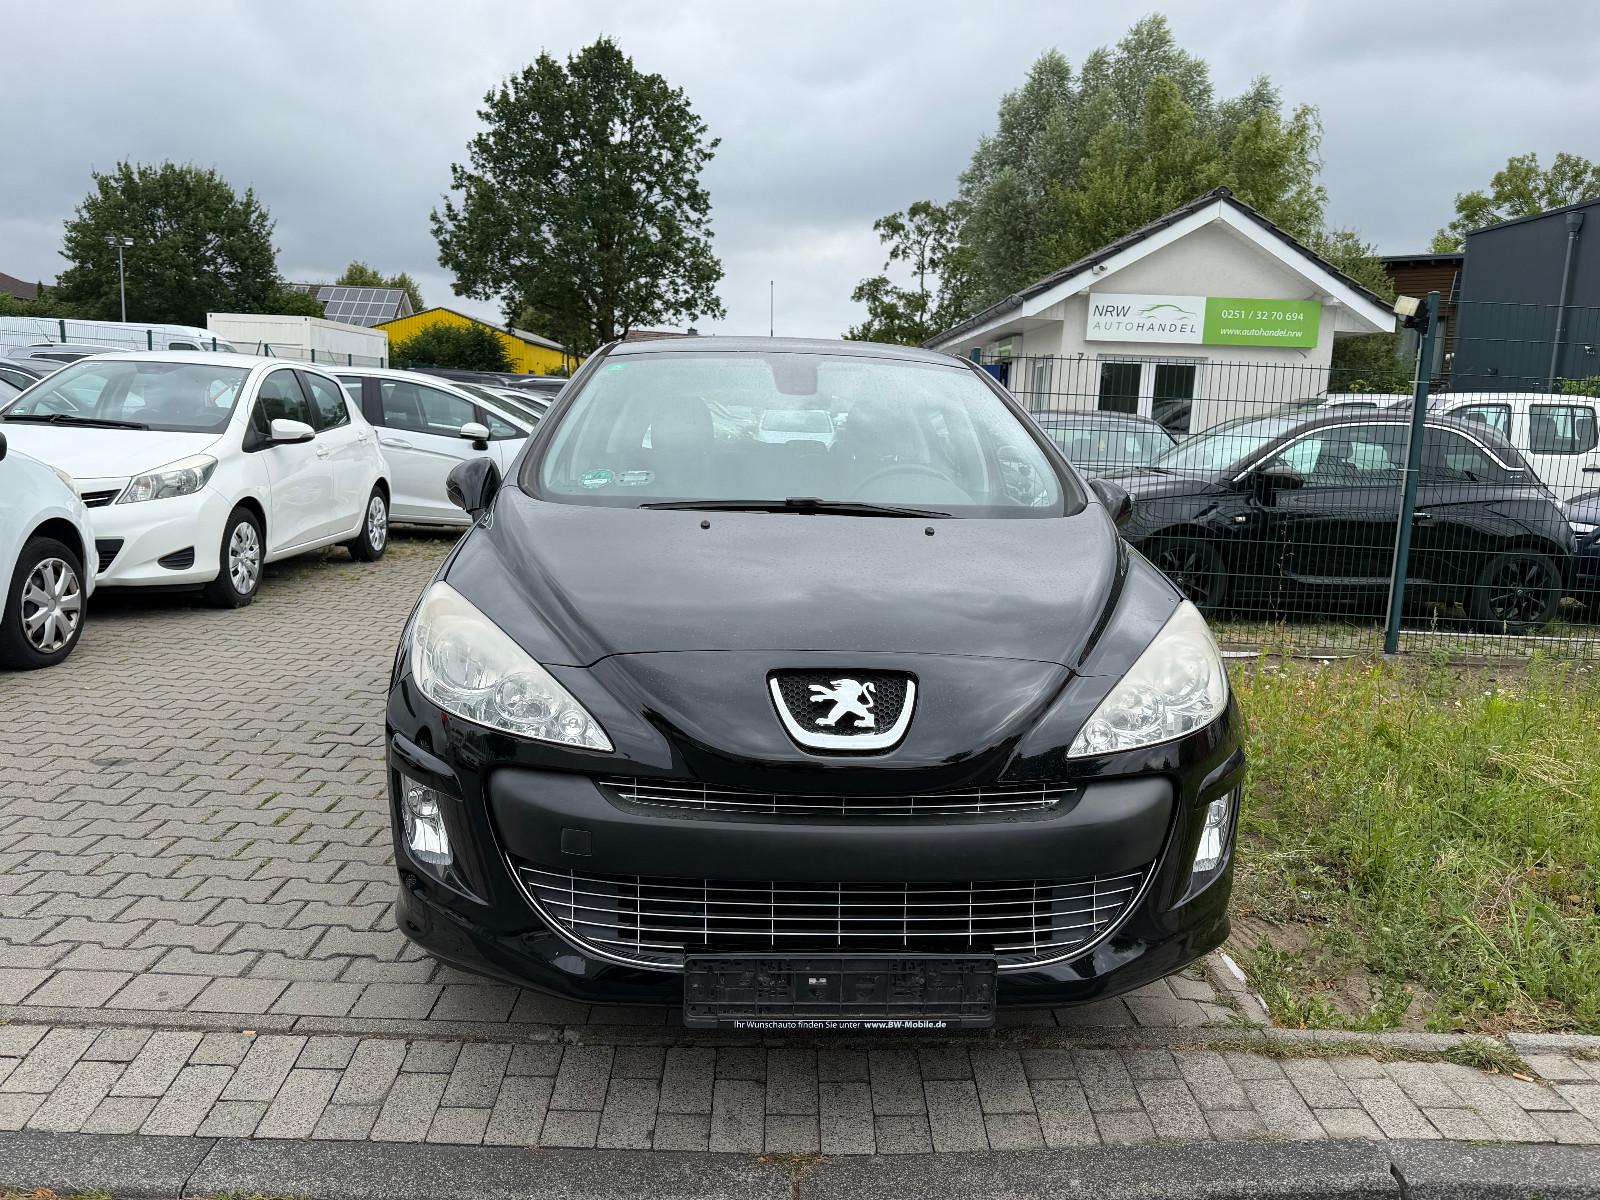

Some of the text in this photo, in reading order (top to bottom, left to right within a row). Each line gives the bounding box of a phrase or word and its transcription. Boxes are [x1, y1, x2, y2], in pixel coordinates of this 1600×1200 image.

[1093, 305, 1131, 317] NRW
[1221, 309, 1246, 319] 0251
[1256, 311, 1268, 320] 32
[1271, 311, 1283, 320] 70
[1285, 312, 1304, 321] 694
[1092, 321, 1197, 334] AUTOHANDEL
[1219, 328, 1303, 337] www.autohandel.nrw
[734, 1020, 947, 1029] Ihr Wunschauto finden Sie unter www.BW-Mobile.de
